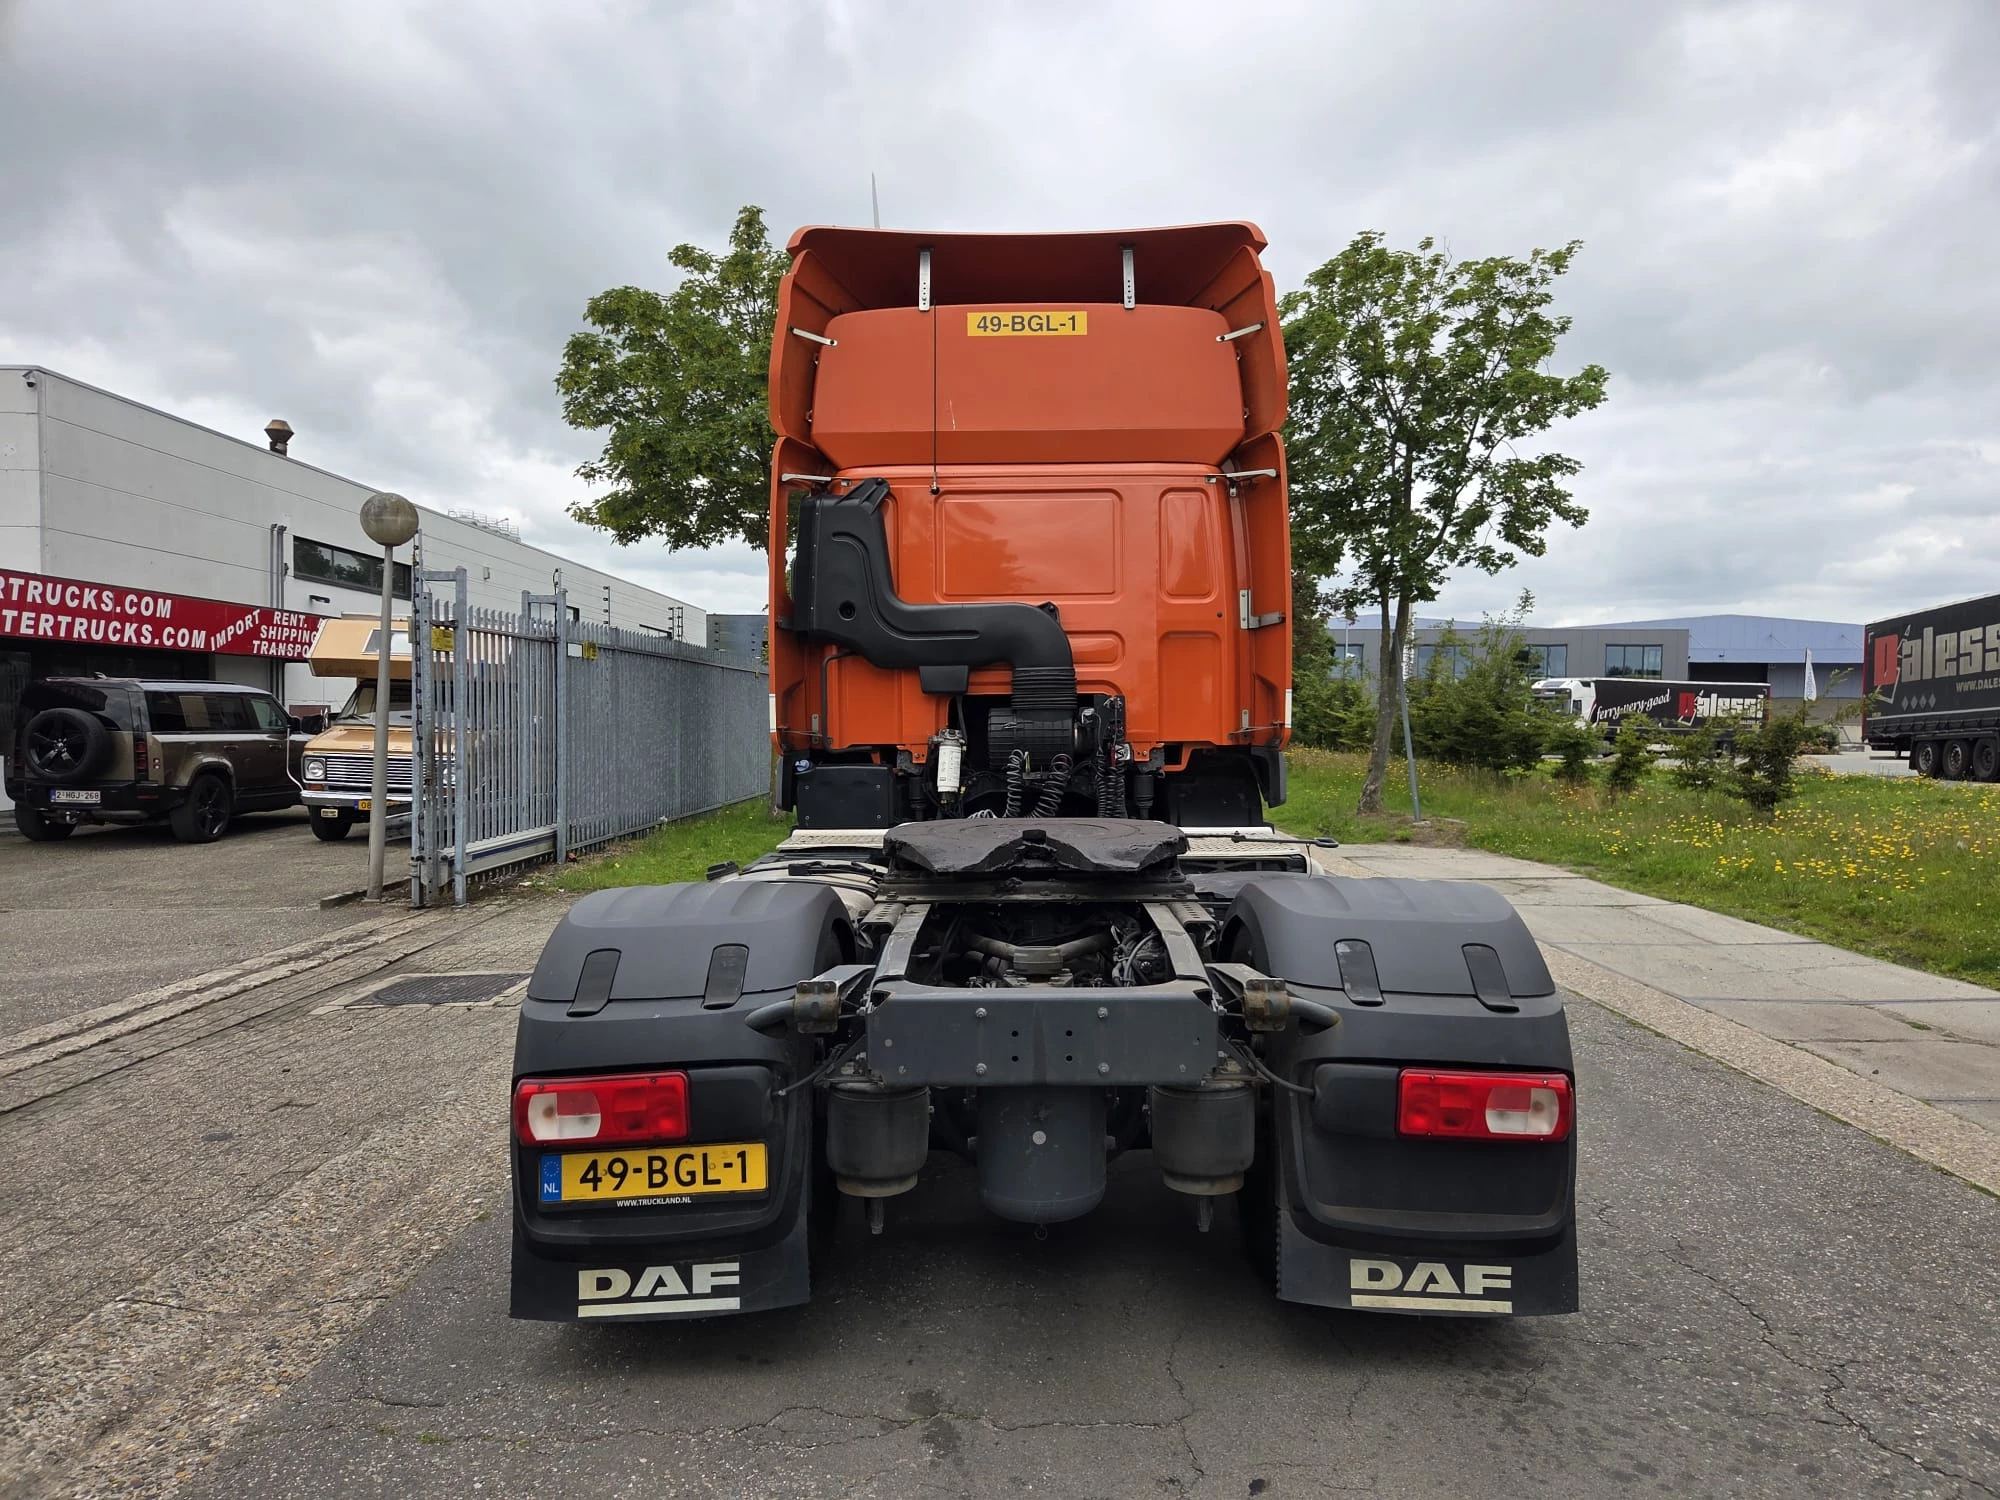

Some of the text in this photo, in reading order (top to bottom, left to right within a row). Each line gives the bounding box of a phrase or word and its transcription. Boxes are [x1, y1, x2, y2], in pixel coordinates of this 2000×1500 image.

[976, 314, 1077, 332] 49-BGL-1
[210, 609, 261, 652] IMPORT
[273, 611, 308, 629] RENT.
[579, 1150, 747, 1192] 49-BGL-1
[543, 1183, 559, 1193] NL
[616, 1197, 692, 1208] WWW.TRUCKLAND.NL
[578, 1262, 740, 1300] DAF
[1350, 1259, 1512, 1295] DAF
